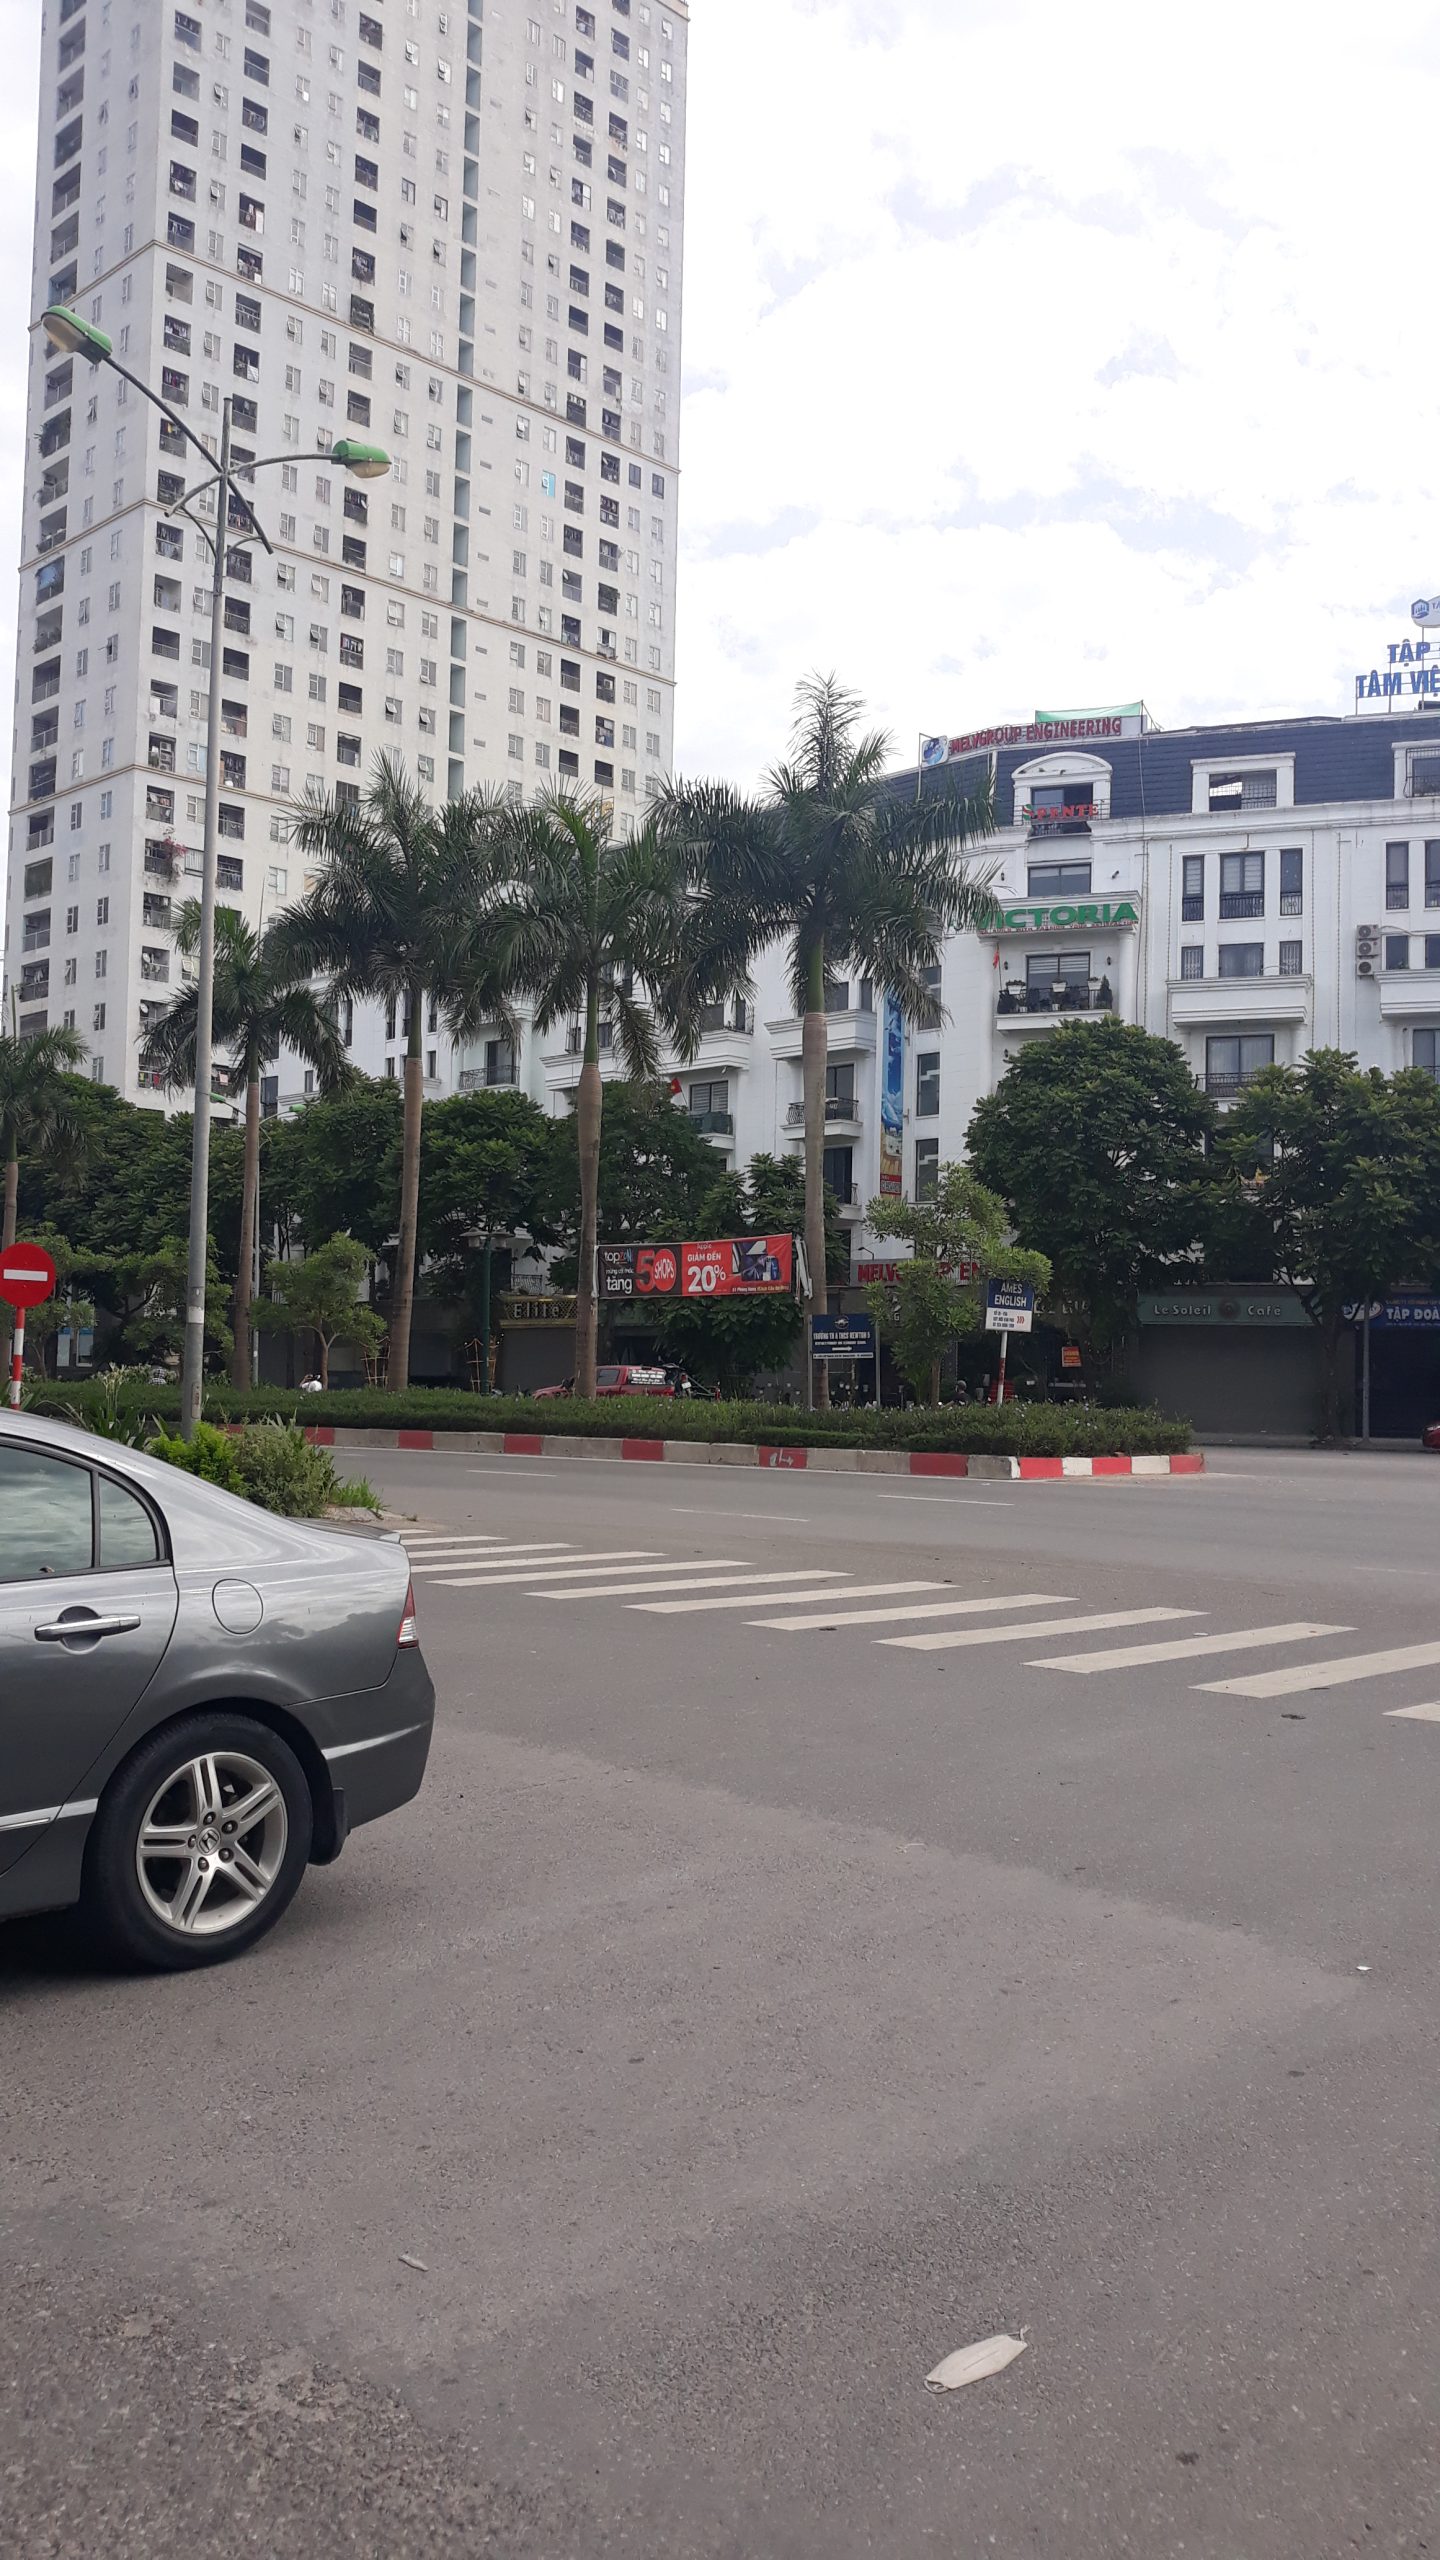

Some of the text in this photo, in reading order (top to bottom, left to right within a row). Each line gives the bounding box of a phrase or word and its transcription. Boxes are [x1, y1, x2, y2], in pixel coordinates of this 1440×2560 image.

[1387, 639, 1431, 667] TẬP
[1356, 669, 1402, 698] TÂM
[1026, 717, 1122, 742] ENGINEERING
[654, 1258, 675, 1280] SHOPS
[687, 1264, 726, 1292] 20%
[606, 1275, 633, 1295] tăng
[1001, 1282, 1023, 1294] AMES
[513, 1302, 560, 1318] Elite
[994, 1294, 1027, 1307] ENGLISH
[1154, 1305, 1169, 1315] Le
[1172, 1304, 1211, 1315] Soleil
[1386, 1306, 1410, 1322] TẬP
